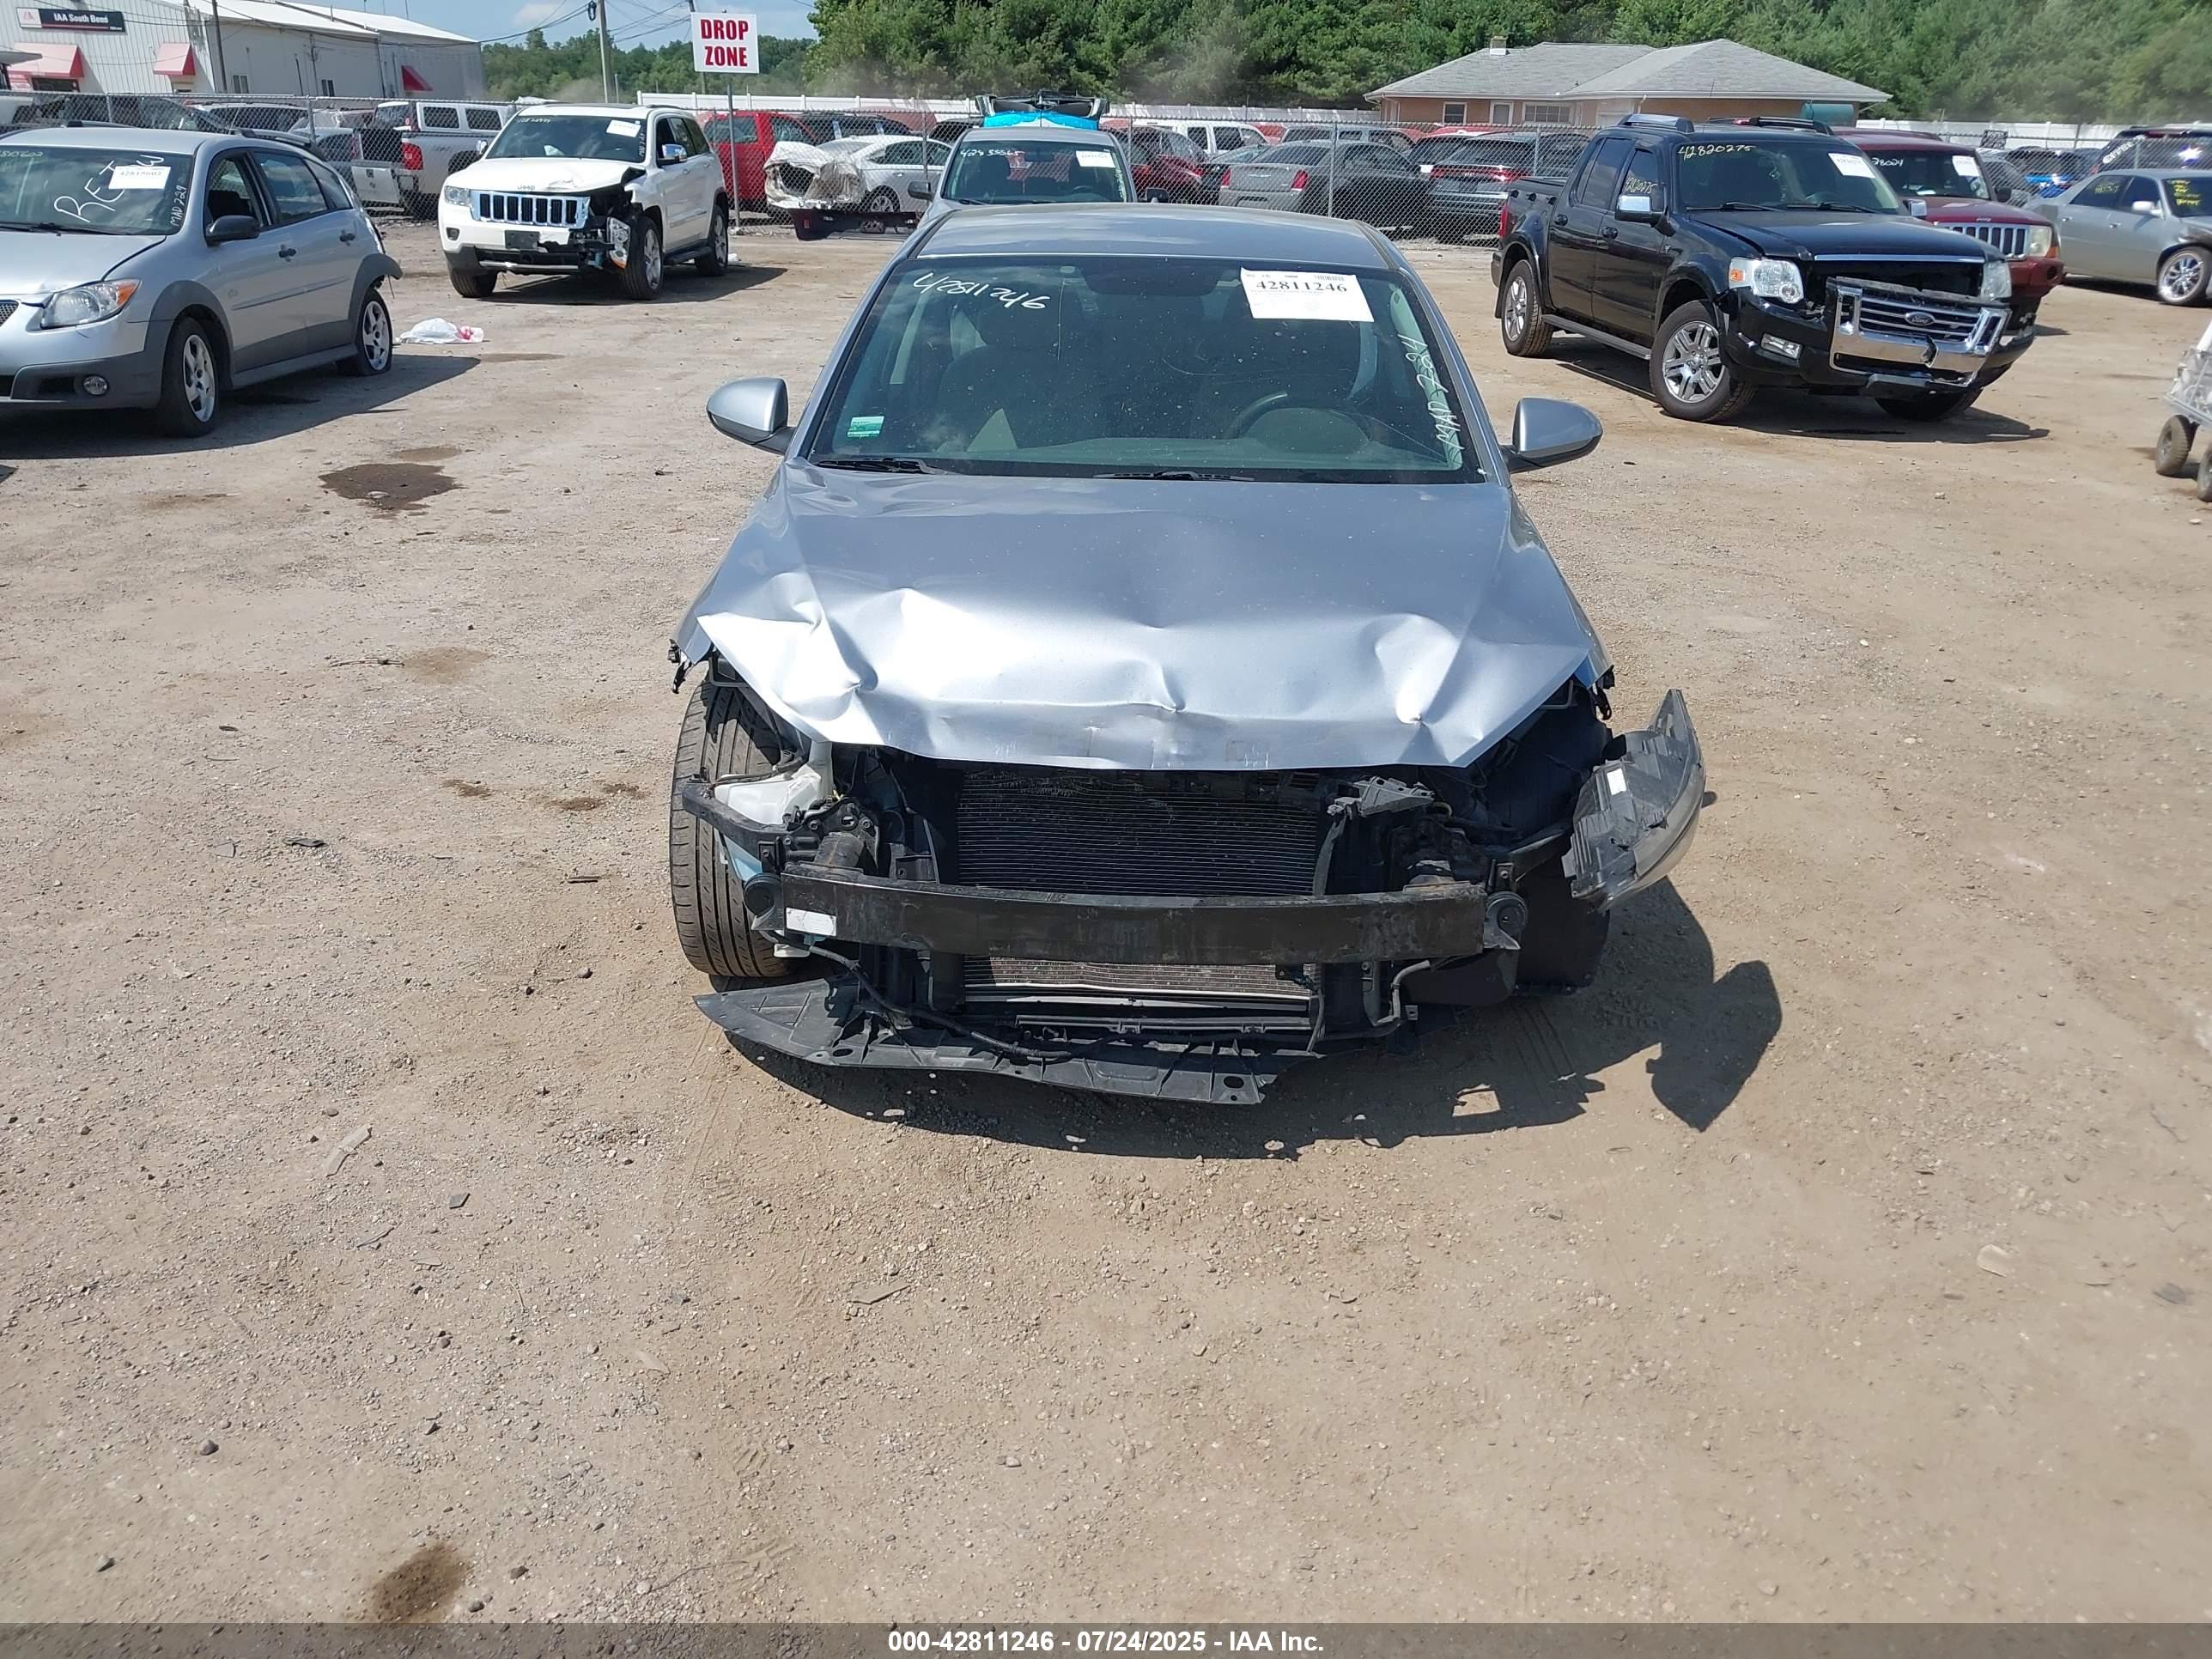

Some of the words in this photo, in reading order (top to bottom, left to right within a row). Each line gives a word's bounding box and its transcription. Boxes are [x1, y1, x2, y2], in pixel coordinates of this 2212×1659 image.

[53, 12, 69, 21] IAA
[69, 13, 90, 22] South
[700, 19, 749, 40] DROP
[704, 46, 748, 67] ZONE
[1677, 144, 1758, 161] 42820275
[913, 272, 1051, 309] 42811246
[1256, 280, 1348, 293] 42811246
